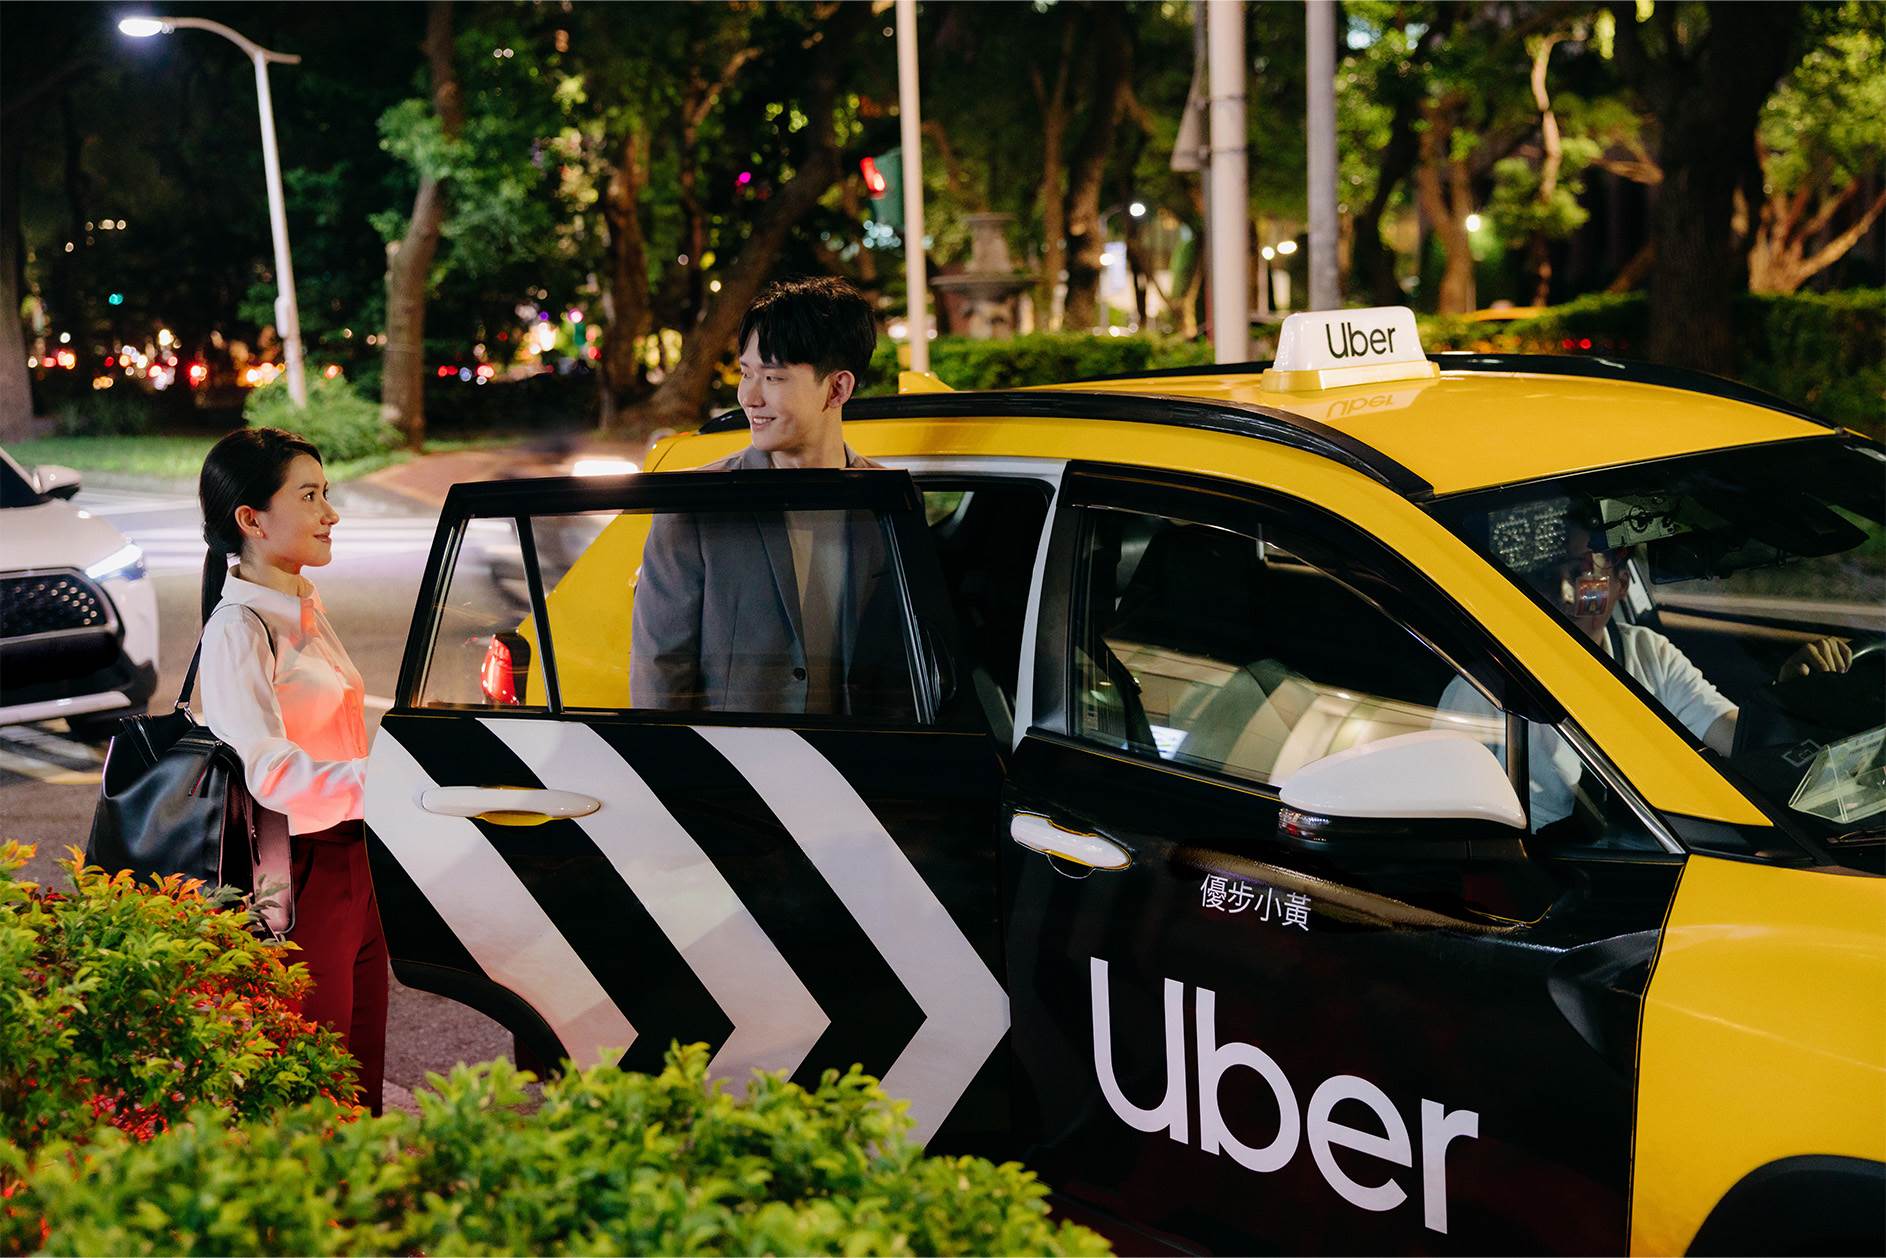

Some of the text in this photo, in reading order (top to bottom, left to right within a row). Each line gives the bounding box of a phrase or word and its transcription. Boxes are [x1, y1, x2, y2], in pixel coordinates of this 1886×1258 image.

[1325, 321, 1396, 359] Uber
[1200, 873, 1312, 932] 優步小黃
[1090, 956, 1480, 1235] Uber
